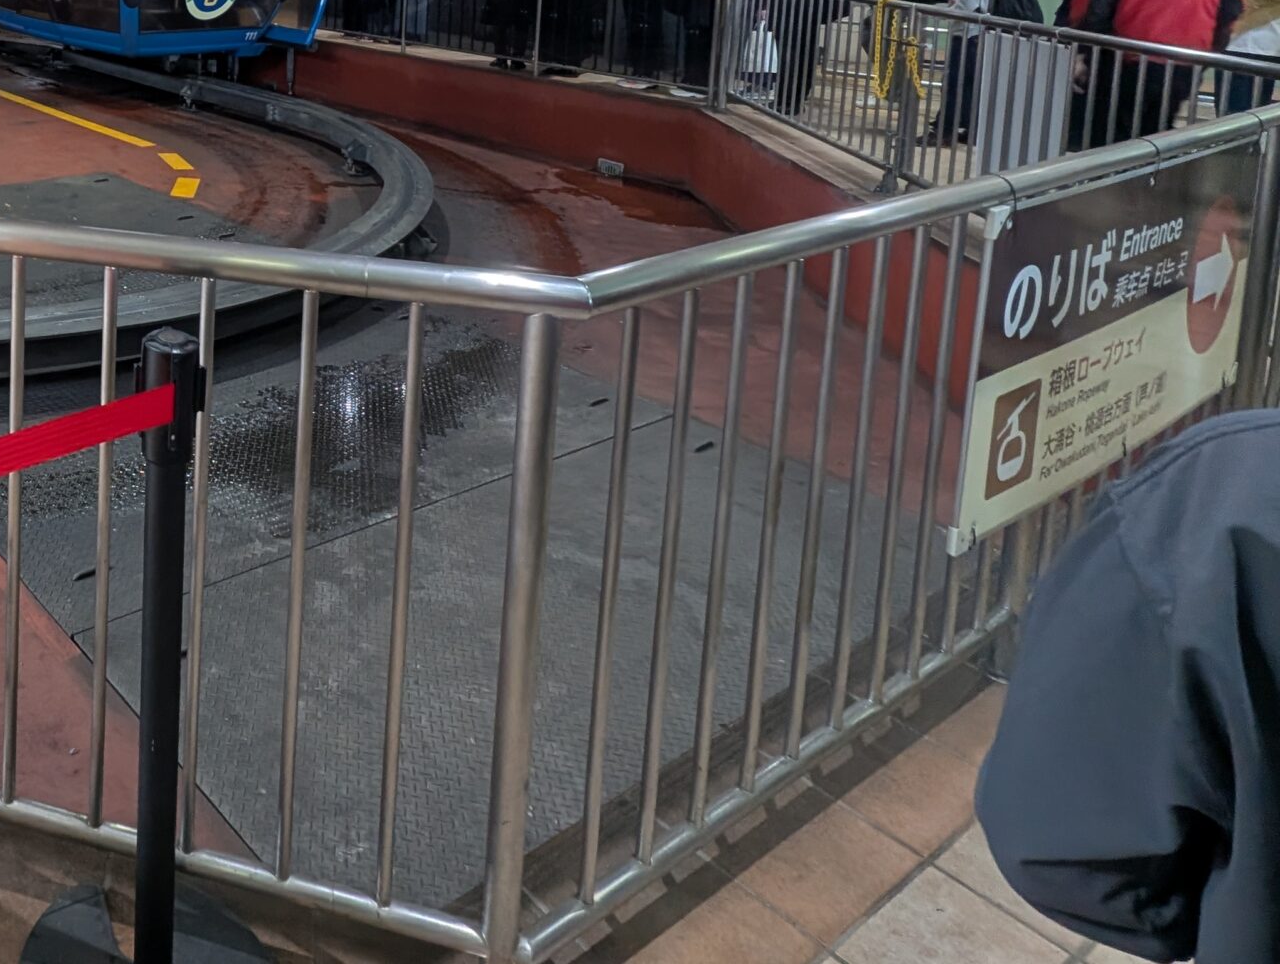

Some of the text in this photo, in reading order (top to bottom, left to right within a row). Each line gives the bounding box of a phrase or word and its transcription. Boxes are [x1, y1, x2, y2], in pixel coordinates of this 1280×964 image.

[1120, 217, 1184, 262] Entrance
[1004, 228, 1116, 340] のりば
[1048, 326, 1146, 398] 箱根ロープウェイ
